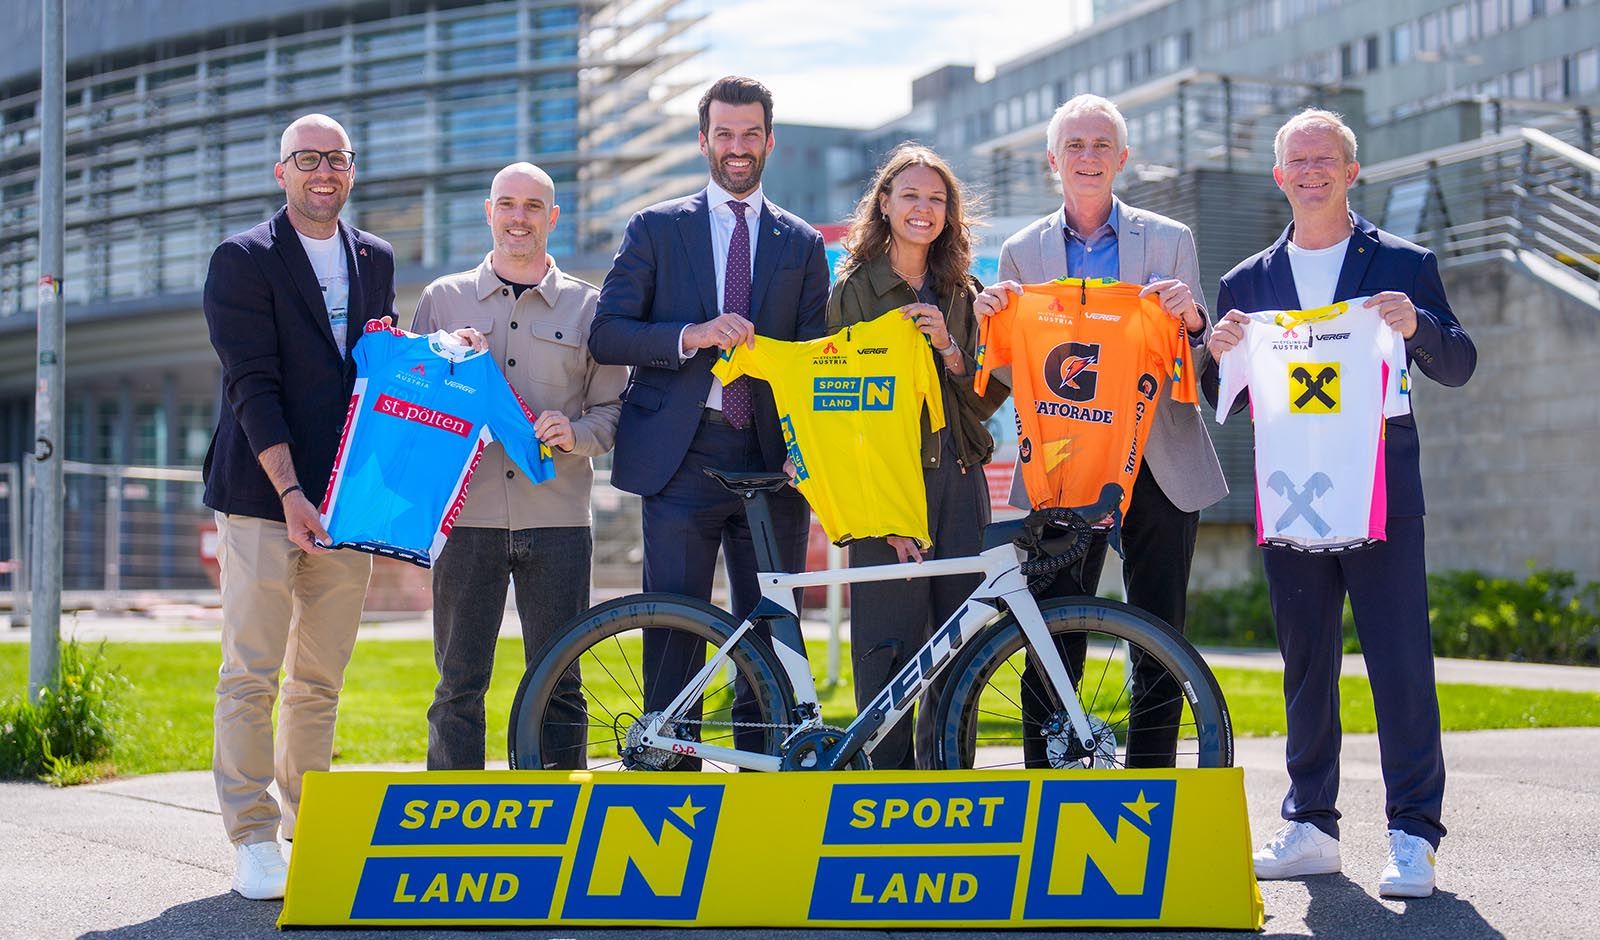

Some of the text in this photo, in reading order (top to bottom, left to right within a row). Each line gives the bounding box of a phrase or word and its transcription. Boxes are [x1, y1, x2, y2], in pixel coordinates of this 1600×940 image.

[1038, 315, 1073, 325] AUSTRIA
[1084, 312, 1122, 322] VERGE
[1315, 332, 1351, 341] VERGE
[857, 347, 889, 355] VERGE
[395, 373, 430, 389] AUSTRIA
[444, 378, 477, 394] VERGE
[819, 381, 857, 390] SPORT
[822, 399, 852, 407] LAND
[866, 382, 890, 406] N
[1034, 400, 1114, 425] ATORADE
[868, 603, 969, 741] FELT
[399, 799, 553, 829] SPORT
[850, 796, 1005, 829] SPORT
[587, 806, 693, 897] N
[1047, 802, 1151, 896] N
[394, 873, 520, 904] LAND
[851, 872, 978, 904] LAND
